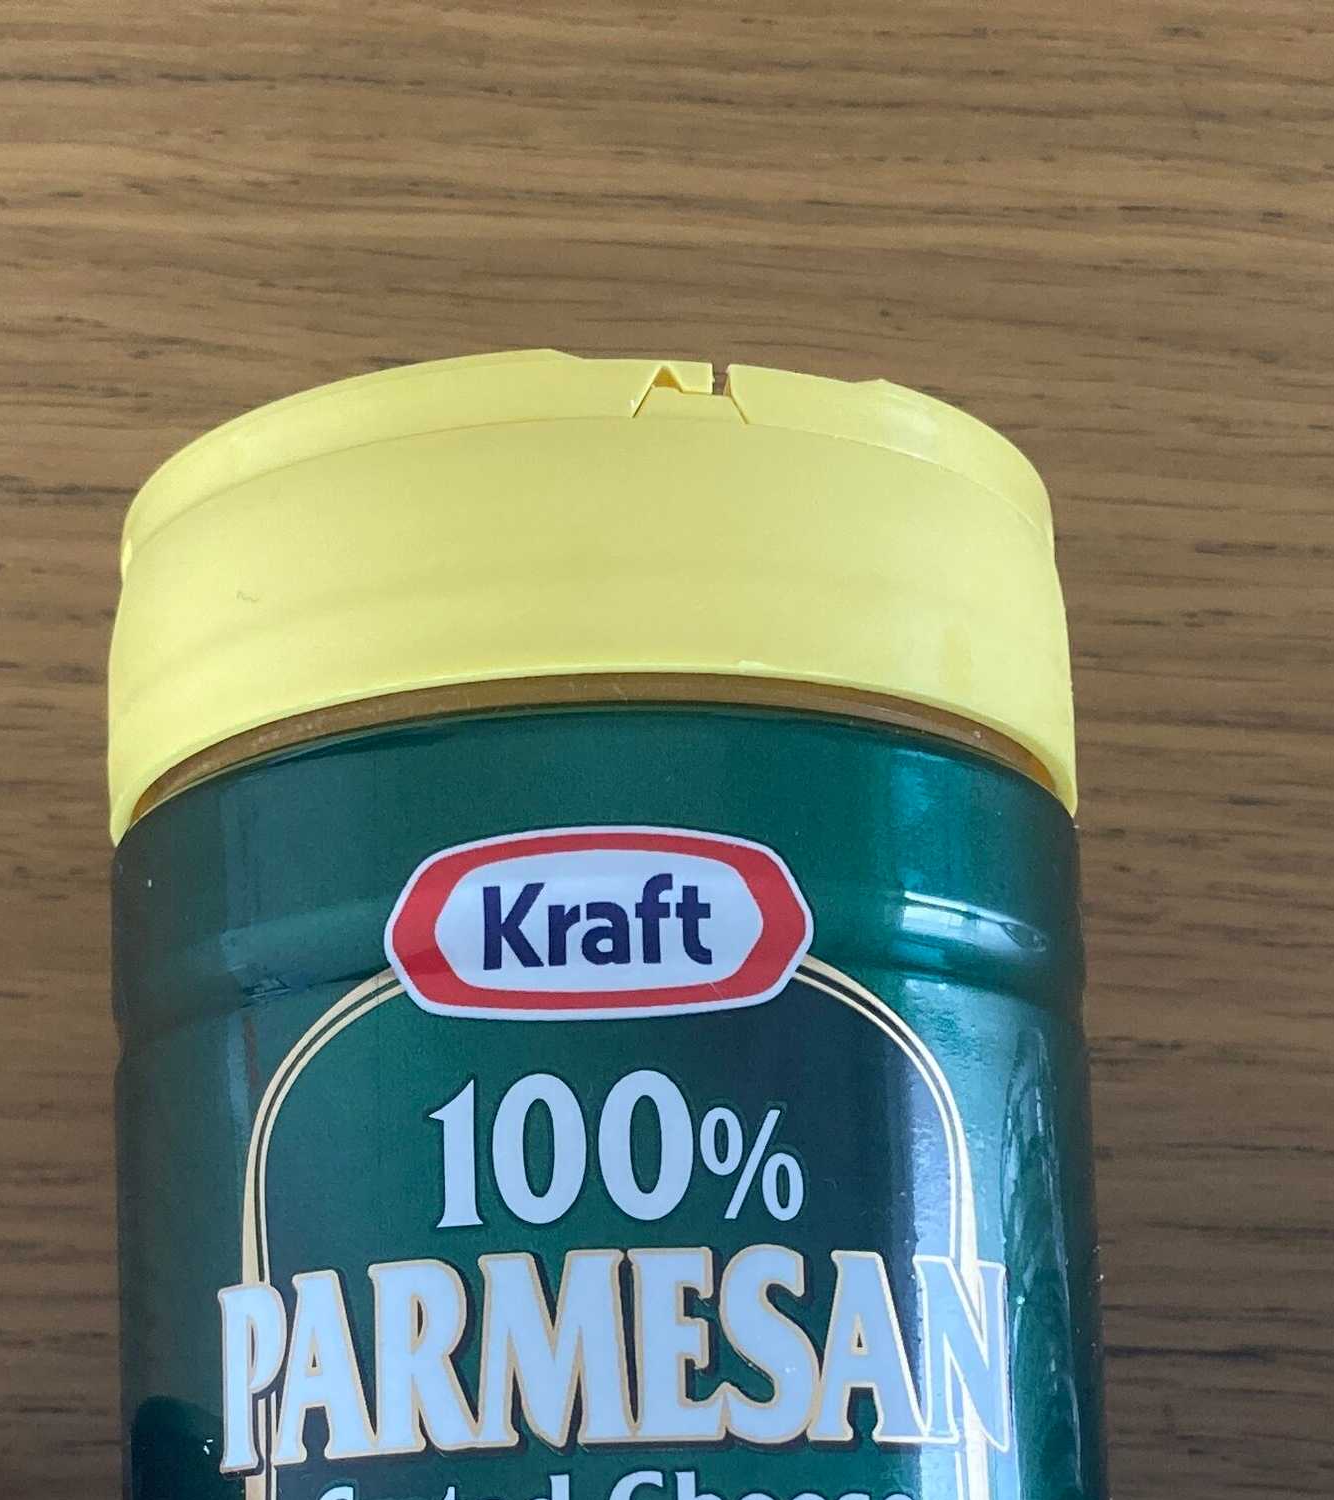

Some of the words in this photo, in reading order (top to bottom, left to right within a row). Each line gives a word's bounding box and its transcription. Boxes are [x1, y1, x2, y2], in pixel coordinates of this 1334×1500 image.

[480, 873, 714, 972] Kraft
[428, 1069, 805, 1229] 100%
[216, 1245, 1012, 1475] PARMESAN
